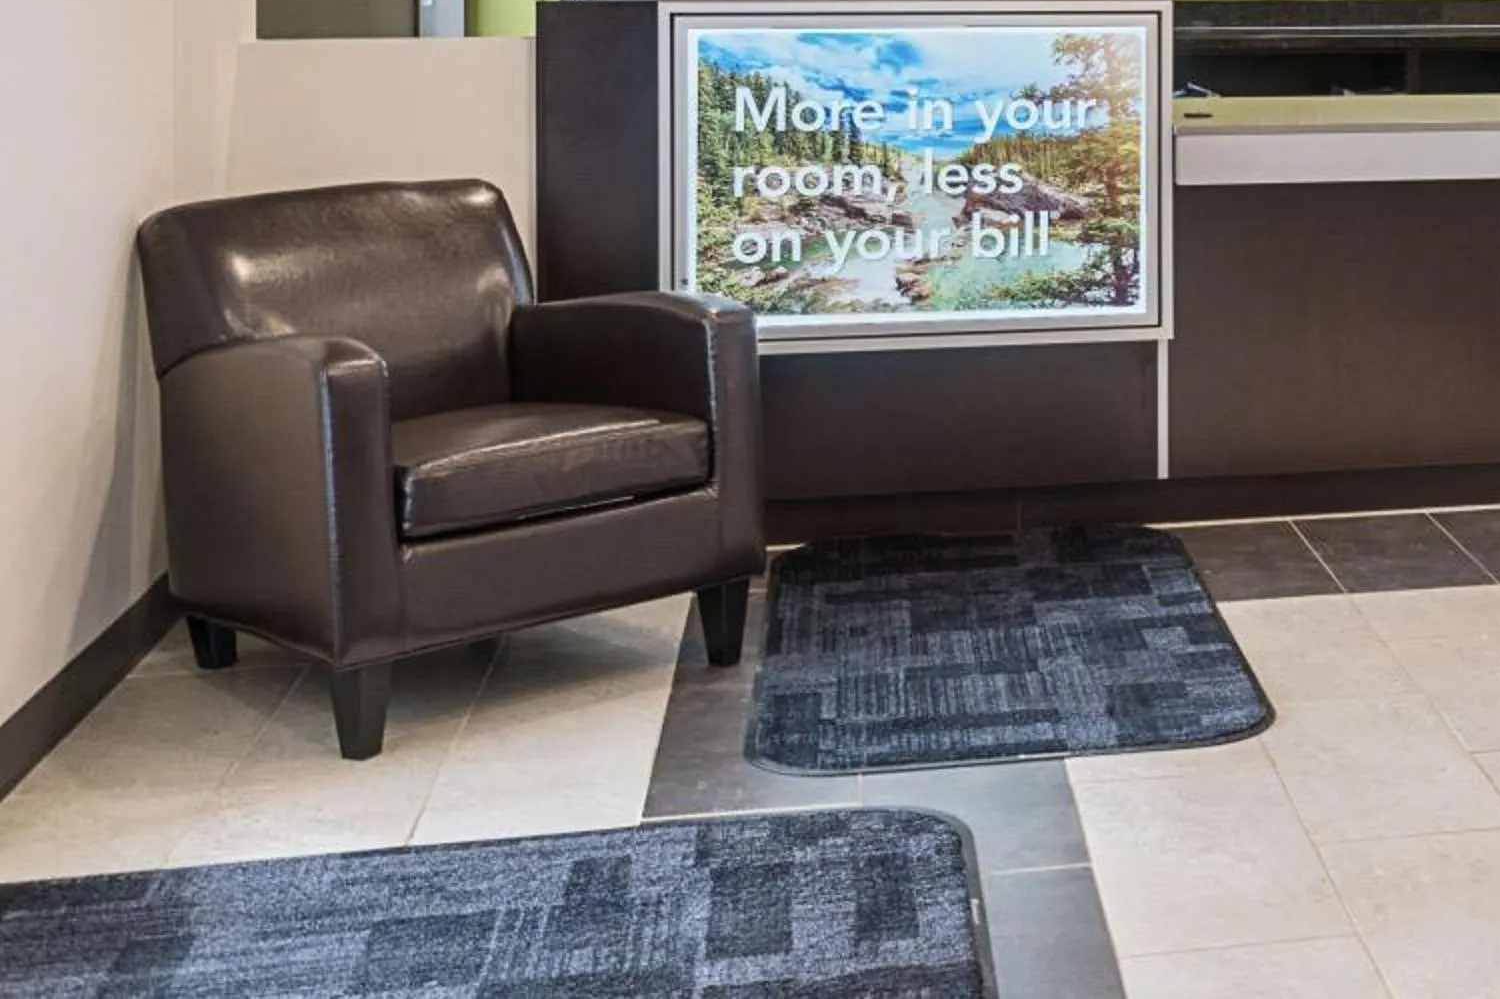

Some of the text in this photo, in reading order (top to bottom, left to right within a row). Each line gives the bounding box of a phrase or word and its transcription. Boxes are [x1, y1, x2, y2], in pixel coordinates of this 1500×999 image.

[735, 87, 1096, 142] More in your
[732, 147, 1024, 203] room, less
[732, 226, 802, 264] on
[827, 226, 954, 273] your
